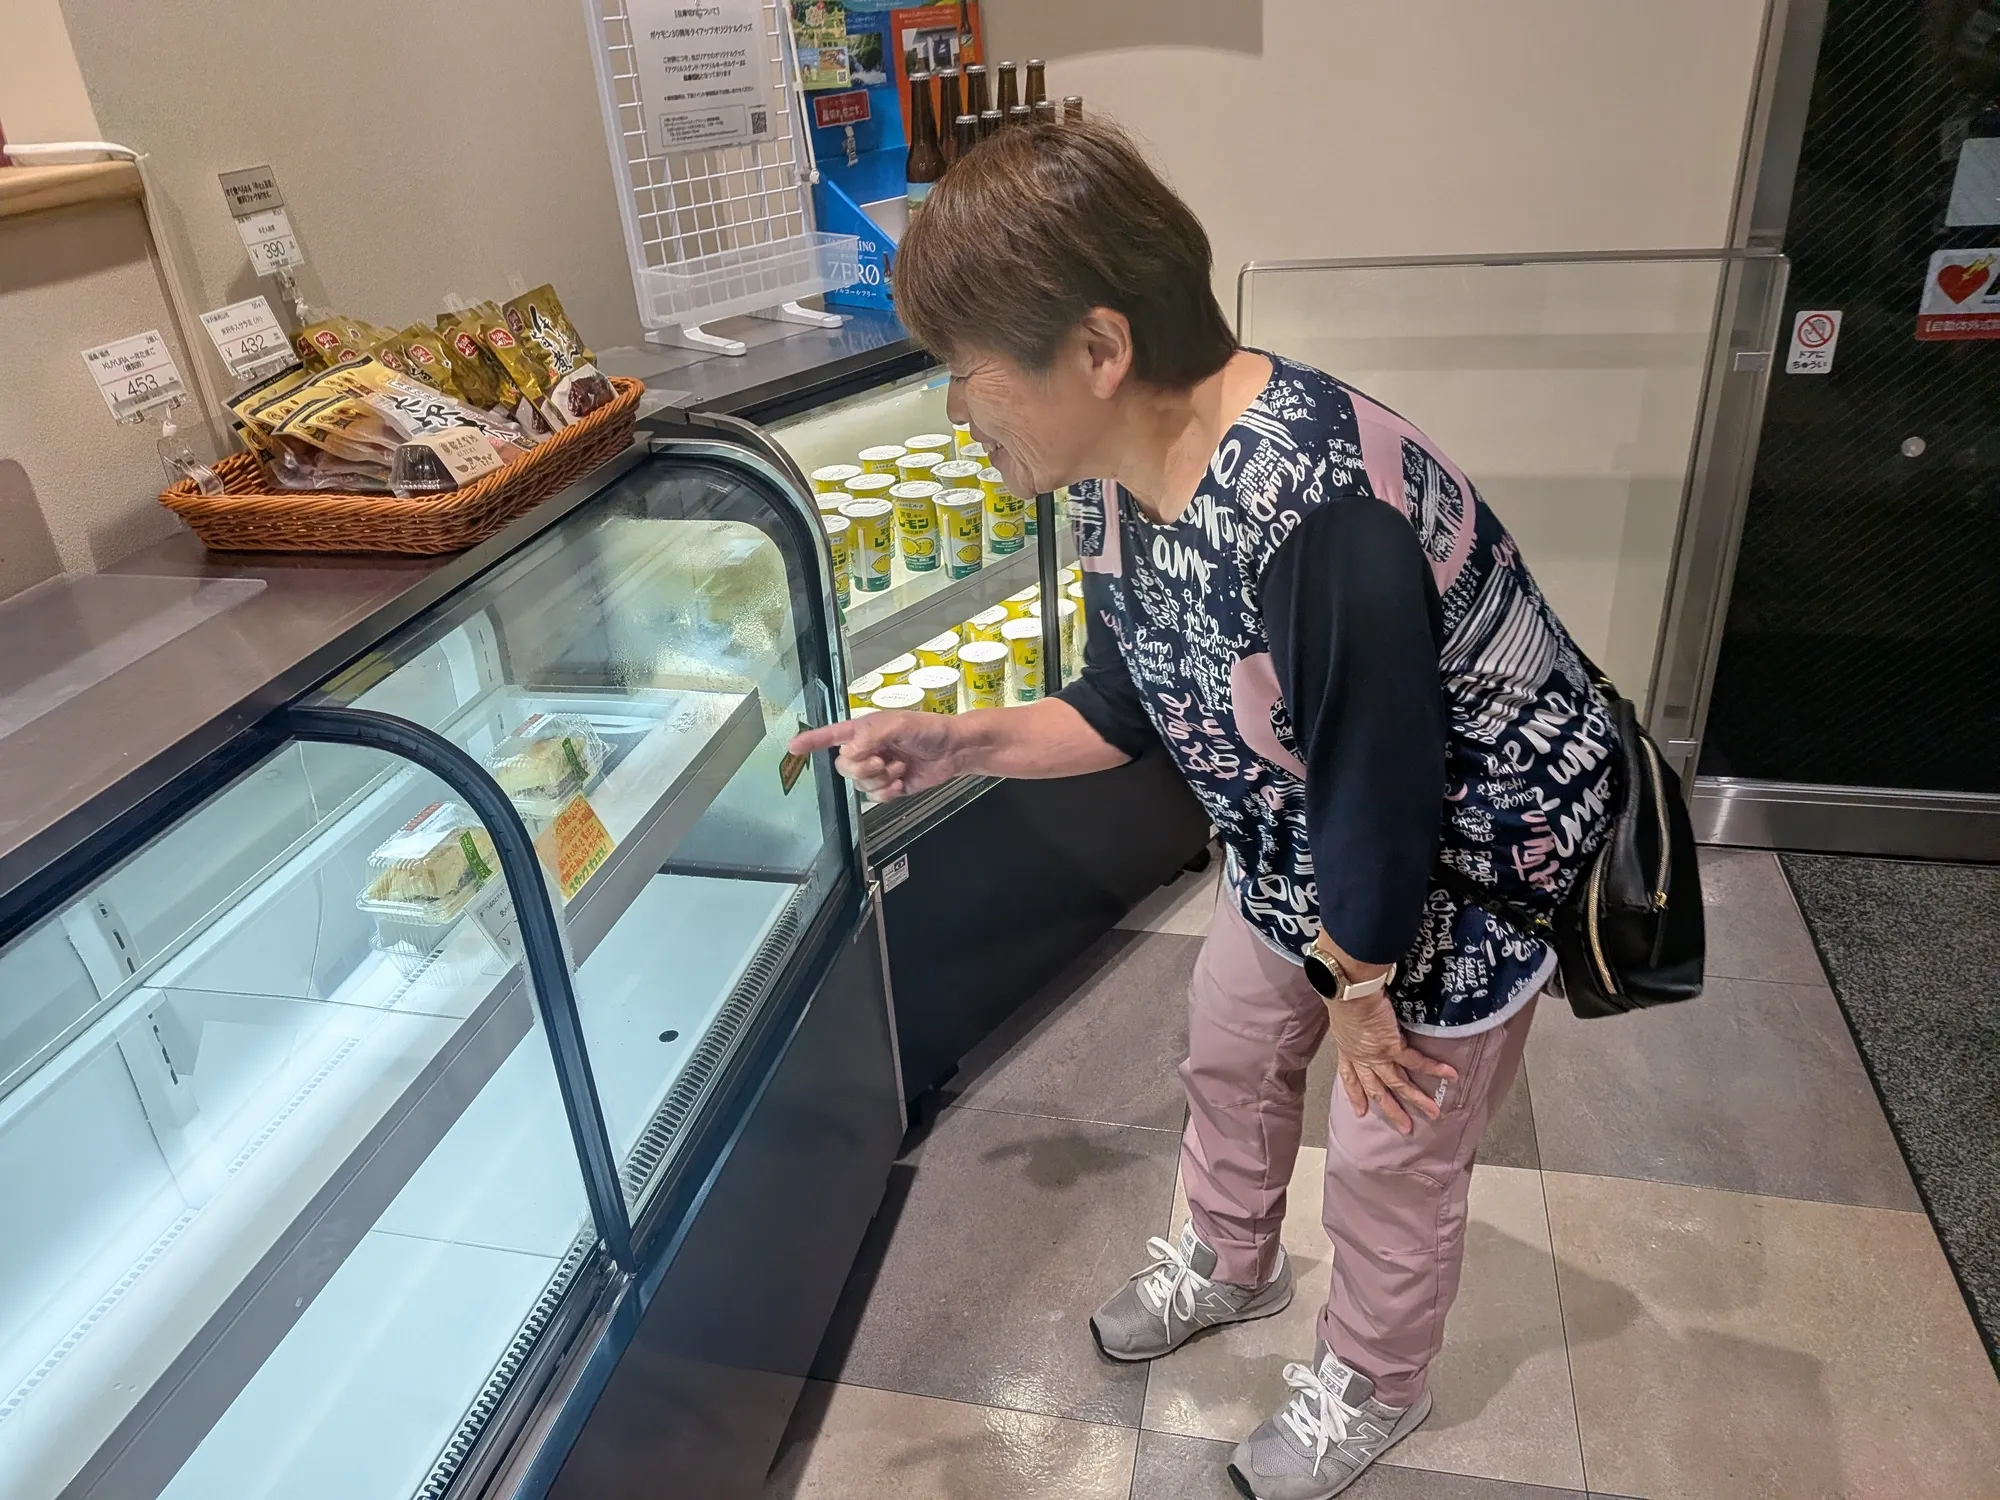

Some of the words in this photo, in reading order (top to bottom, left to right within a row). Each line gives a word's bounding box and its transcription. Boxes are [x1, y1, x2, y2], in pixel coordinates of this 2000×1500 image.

[263, 241, 285, 259] 390
[241, 334, 268, 354] 432
[101, 356, 130, 370] KUYURA
[128, 374, 159, 397] 453
[899, 517, 929, 530] レモン
